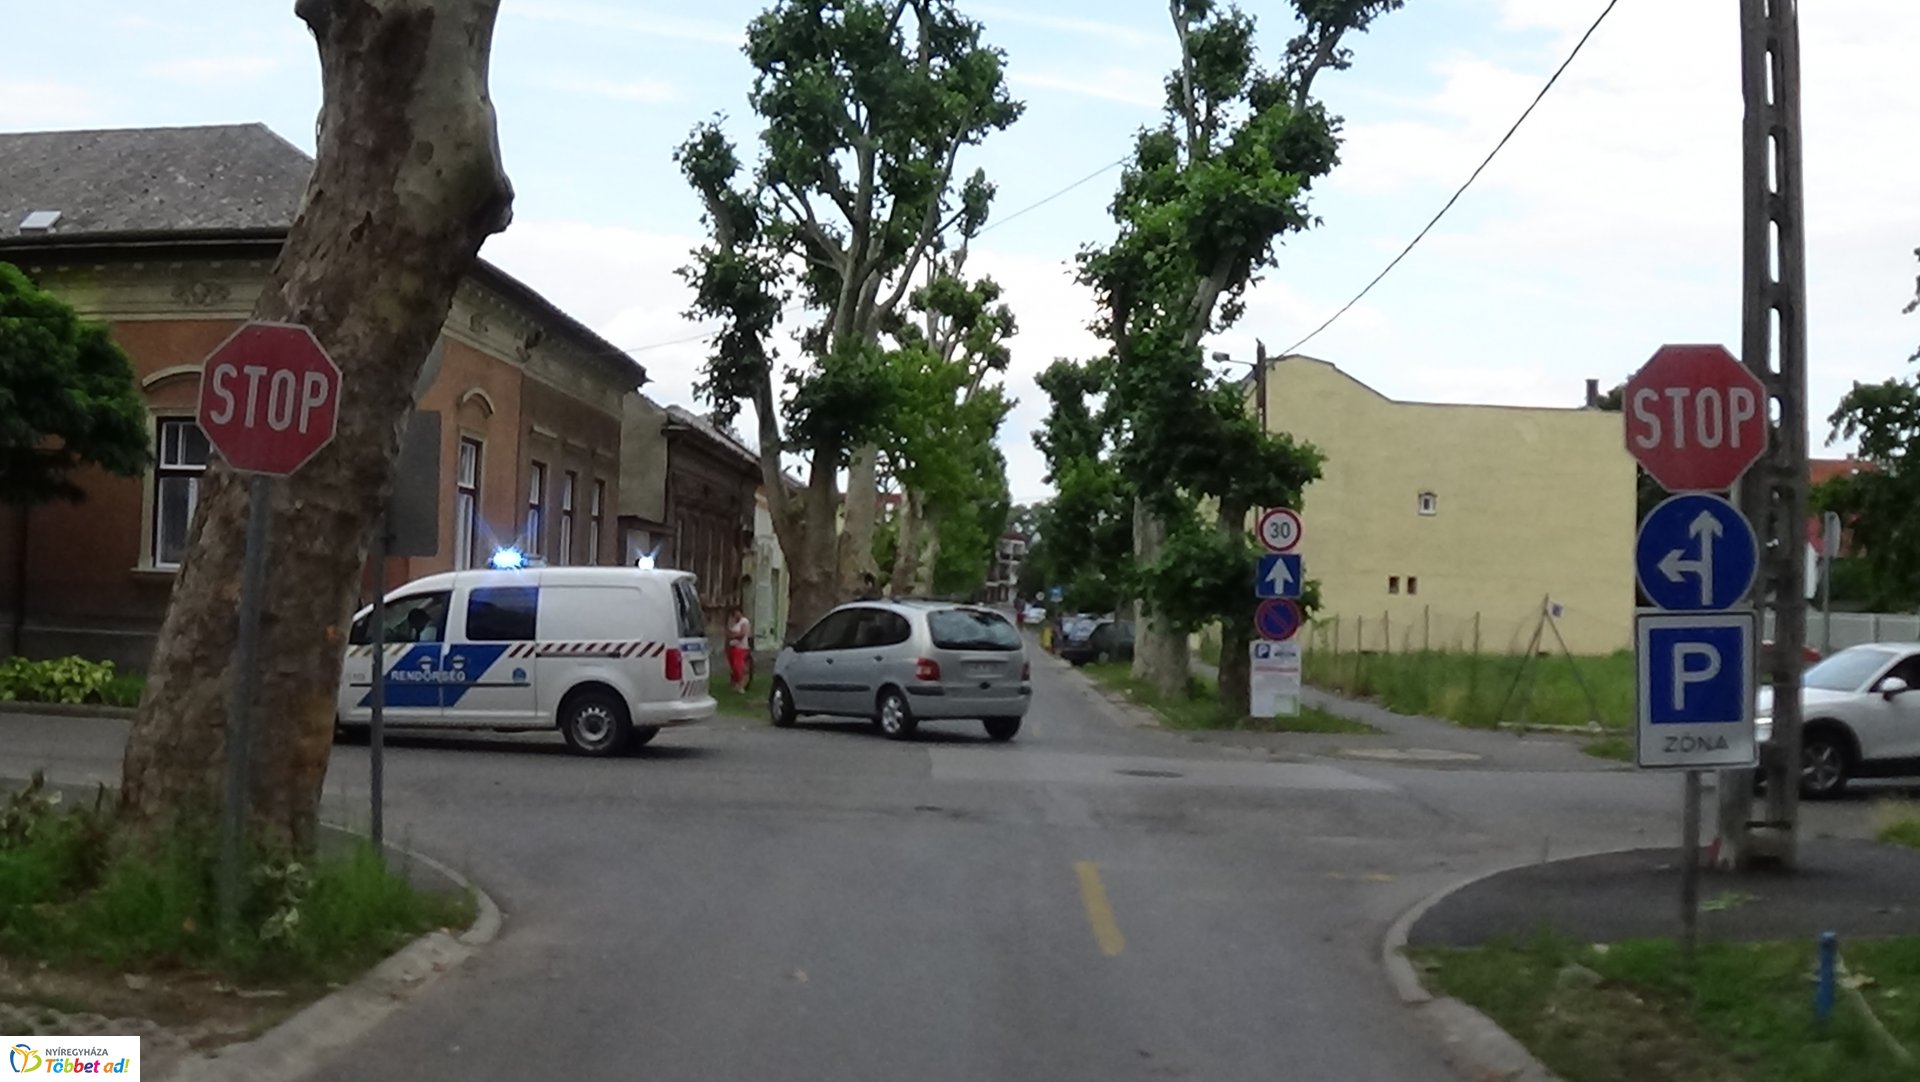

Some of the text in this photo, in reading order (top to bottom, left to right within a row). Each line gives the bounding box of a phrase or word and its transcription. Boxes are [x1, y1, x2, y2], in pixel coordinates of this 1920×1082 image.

[210, 363, 329, 435] STOP
[1633, 387, 1755, 448] STOP
[1270, 521, 1291, 540] 30
[1672, 641, 1722, 711] P
